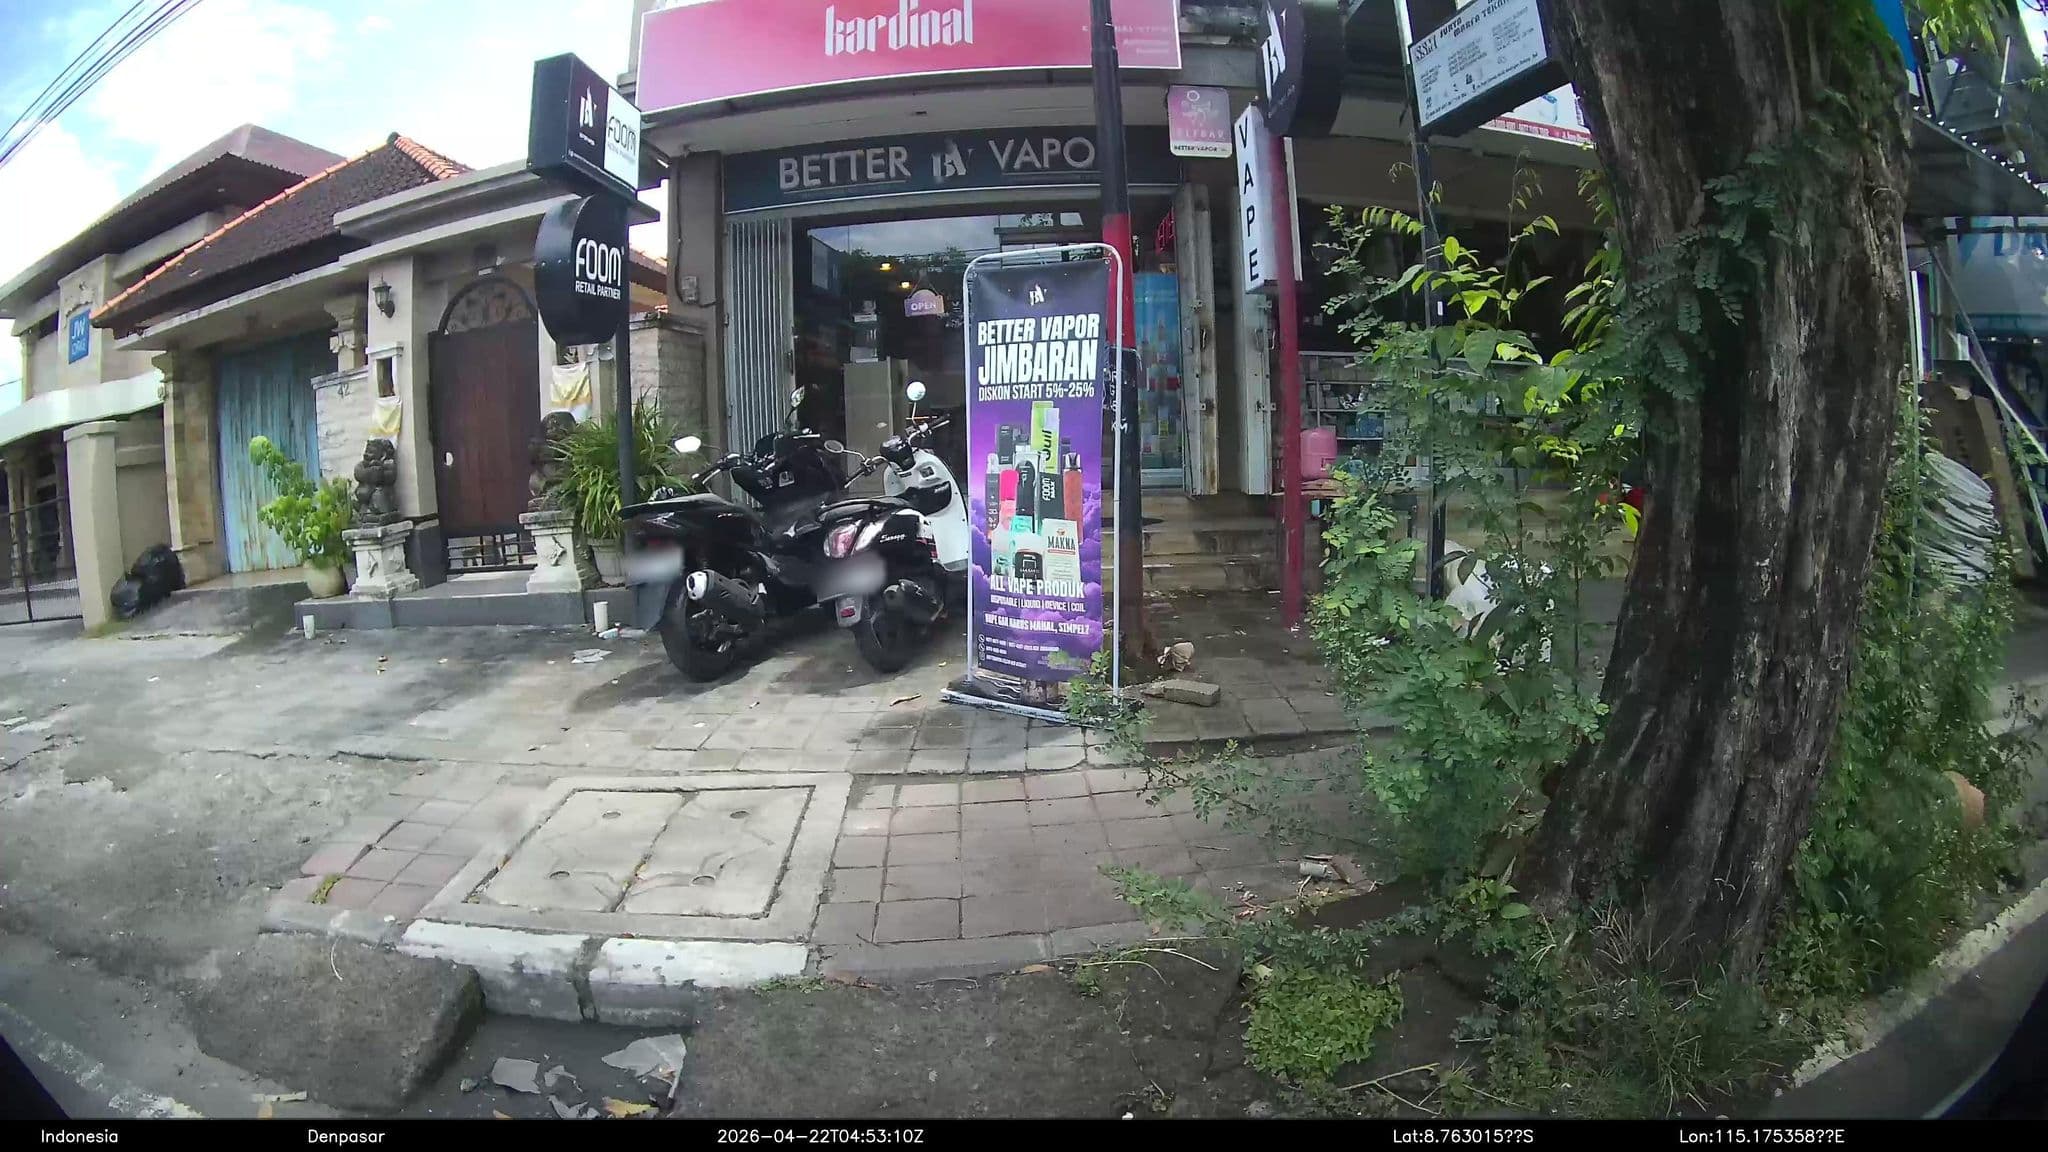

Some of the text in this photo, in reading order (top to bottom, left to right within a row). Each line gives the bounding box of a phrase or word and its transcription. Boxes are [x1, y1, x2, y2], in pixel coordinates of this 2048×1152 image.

[825, 0, 974, 56] kardinal
[607, 116, 636, 156] FOOM
[779, 146, 911, 190] BETTER
[988, 136, 1097, 171] VAPO
[1239, 117, 1259, 282] VAPE
[575, 238, 622, 286] FOOM
[575, 280, 621, 300] RETAIL PARTNER
[911, 302, 937, 311] OPEN
[978, 313, 1100, 346] BETTER VAPOR
[978, 339, 1098, 386] JIMBARAN
[337, 382, 351, 399] 42
[979, 381, 1095, 402] DISKON START 5%-25%
[1047, 535, 1076, 551] MAKNA
[990, 575, 1085, 599] ALL VAPE PRODUK
[1045, 600, 1067, 612] DEVICE
[1070, 602, 1086, 613] COIL
